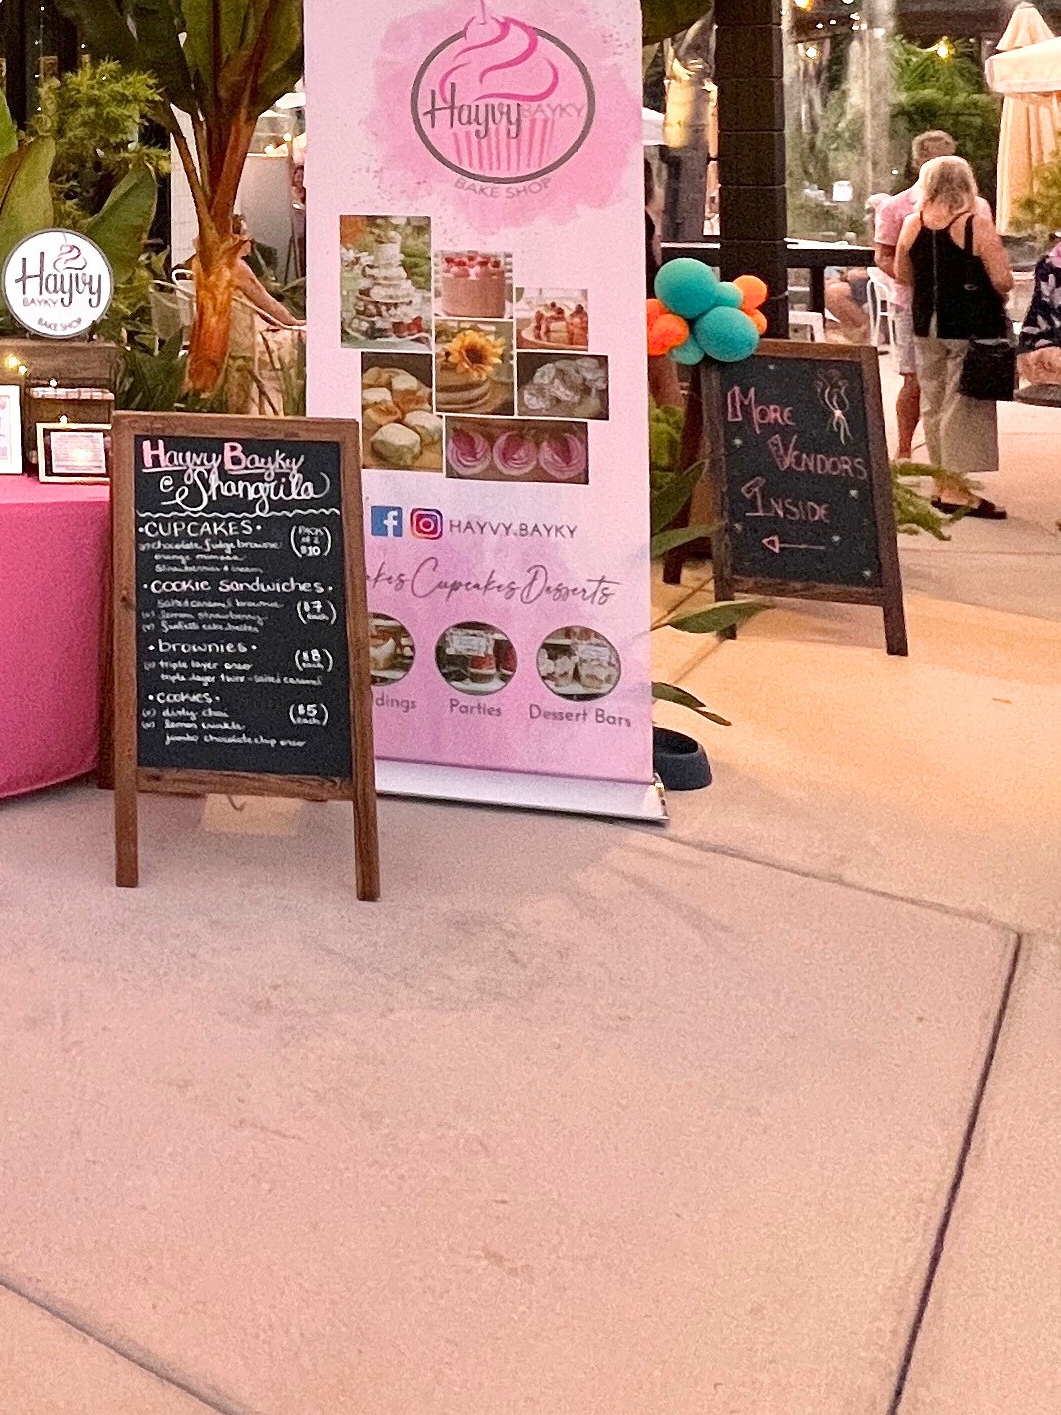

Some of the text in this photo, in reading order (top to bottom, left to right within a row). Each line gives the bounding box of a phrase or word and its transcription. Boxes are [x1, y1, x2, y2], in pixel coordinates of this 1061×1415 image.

[422, 81, 585, 140] Hayvy BAYKY
[453, 176, 552, 199] BAKE SHOP
[14, 251, 102, 308] Hayvy
[142, 439, 222, 484] Hayvy
[223, 441, 305, 482] Bayky
[144, 520, 253, 537] CUPCAKES
[449, 519, 578, 539] HAYVY.BAYKY
[411, 556, 522, 602] Cupcakes
[520, 564, 621, 606] Desserts
[158, 638, 248, 653] brownies
[448, 697, 502, 717] Parties
[529, 703, 589, 723] Dessert
[594, 708, 631, 728] Bars
